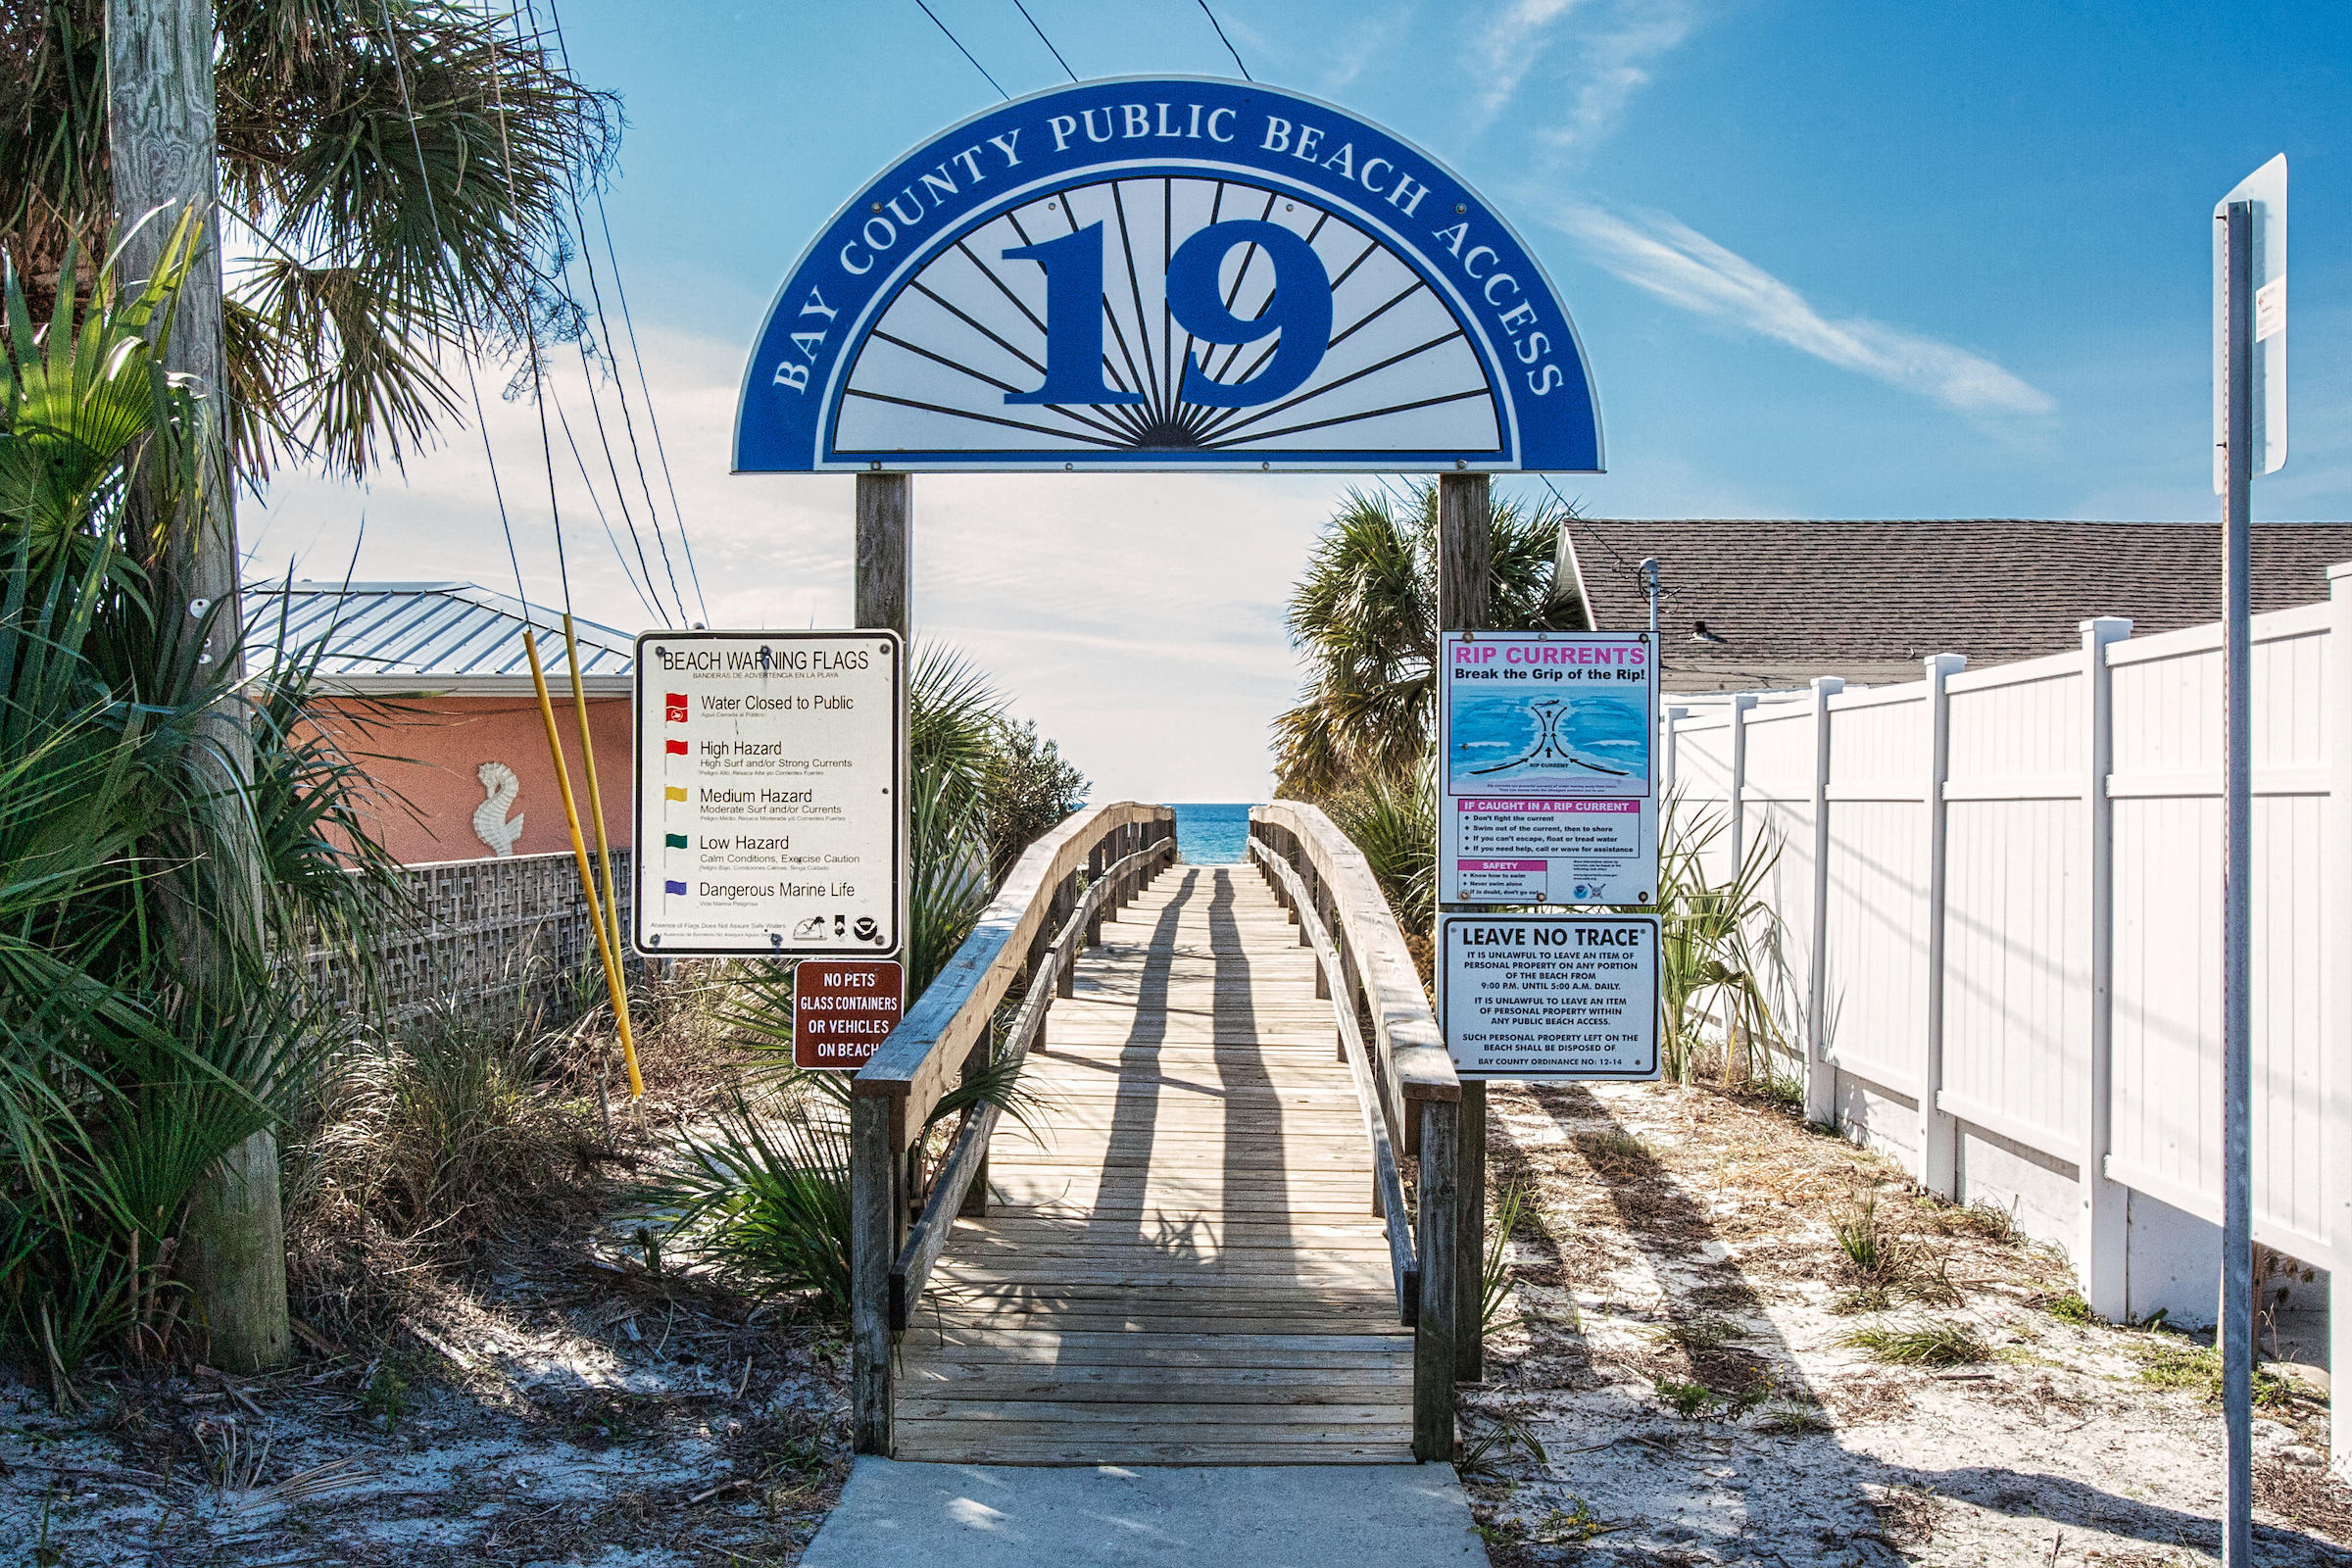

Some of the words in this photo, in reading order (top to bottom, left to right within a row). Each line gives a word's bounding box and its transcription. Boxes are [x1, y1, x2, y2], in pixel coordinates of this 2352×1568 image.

[772, 285, 839, 395] BAY
[840, 127, 1022, 275] COUNTY
[1047, 102, 1237, 153] PUBLIC
[1259, 115, 1432, 219] BEACH
[1431, 221, 1564, 396] ACCESS
[1002, 219, 1334, 409] 19
[663, 651, 721, 670] BEACH
[726, 651, 807, 670] WARNING
[813, 651, 868, 669] FLAGS
[1456, 647, 1496, 663] RIP
[1505, 647, 1644, 664] CURRENTS
[1455, 668, 1498, 679] Break
[1503, 668, 1527, 679] the
[1533, 668, 1563, 682] Grip
[1568, 668, 1583, 679] of
[1588, 668, 1611, 680] the
[1617, 668, 1644, 682] Rip!
[701, 696, 741, 710] Water
[745, 695, 792, 710] Closed
[797, 696, 809, 710] to
[814, 695, 854, 710] Public
[701, 741, 729, 759] High
[734, 741, 781, 756] Hazard
[701, 758, 721, 769] High
[724, 759, 744, 767] Surf
[778, 759, 809, 769] Strong
[812, 759, 853, 767] Currents
[701, 788, 755, 803] Medium
[760, 788, 812, 803] Hazard
[700, 805, 745, 813] Moderate
[747, 805, 766, 813] Surf
[769, 805, 799, 813] and/or
[802, 805, 842, 813] Currents
[1478, 802, 1525, 810] CAUGHT
[1528, 802, 1540, 810] IN
[1543, 802, 1550, 810] A
[1575, 803, 1629, 811] CURRENT
[700, 835, 730, 850] Low
[736, 835, 789, 850] Hazard
[700, 854, 724, 863] Calm
[727, 854, 777, 863] Conditions,
[781, 854, 821, 863] Exercise
[824, 854, 859, 863] Caution
[700, 882, 774, 901] Dangerous
[780, 882, 826, 897] Marine
[831, 882, 855, 897] Life
[1463, 928, 1525, 946] LEAVE
[1534, 928, 1568, 946] NO
[1575, 928, 1639, 947] TRACE
[824, 973, 841, 987] NO
[845, 973, 875, 987] PETS
[801, 997, 833, 1010] GLASS
[835, 997, 897, 1010] CONTAINERS
[808, 1019, 825, 1033] OR
[829, 1019, 889, 1034] VEHICLES
[818, 1043, 835, 1056] ON
[838, 1043, 879, 1056] BEACH
